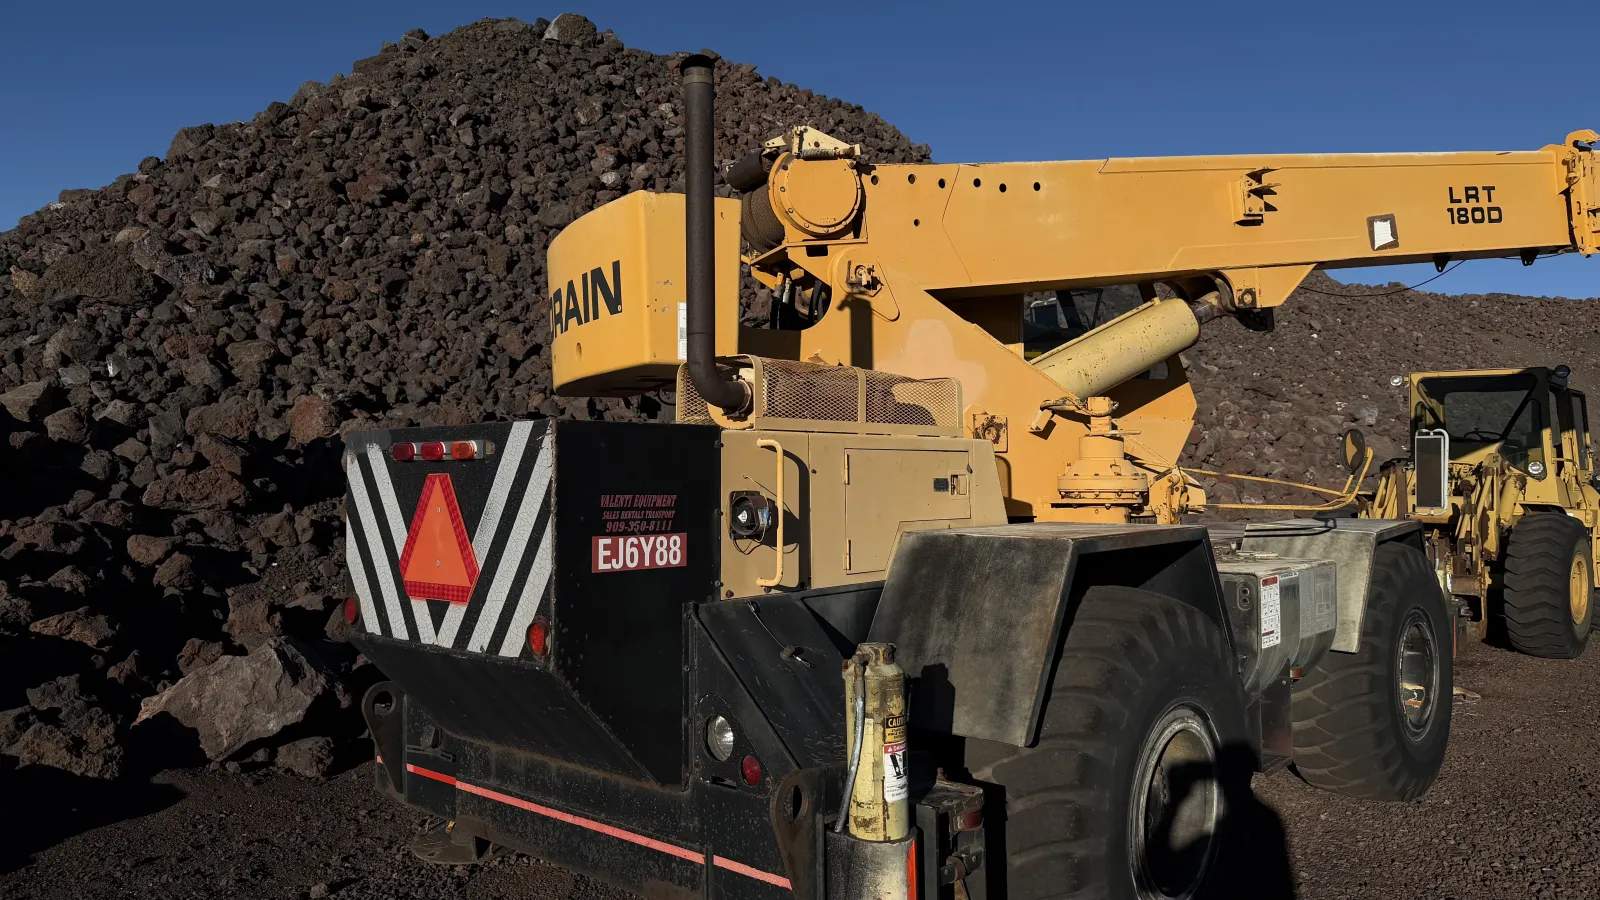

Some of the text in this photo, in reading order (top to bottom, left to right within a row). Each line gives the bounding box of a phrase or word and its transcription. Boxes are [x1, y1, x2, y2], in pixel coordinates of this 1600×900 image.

[1448, 185, 1496, 204] LRT
[1446, 206, 1503, 225] 180D
[549, 259, 622, 339] RAIN
[600, 494, 677, 509] VALENTI EQUIPMENT
[602, 510, 676, 520] SALES RENTALS TRANSPORT
[605, 520, 672, 533] 909-350-8111
[598, 535, 682, 570] EJ6Y88
